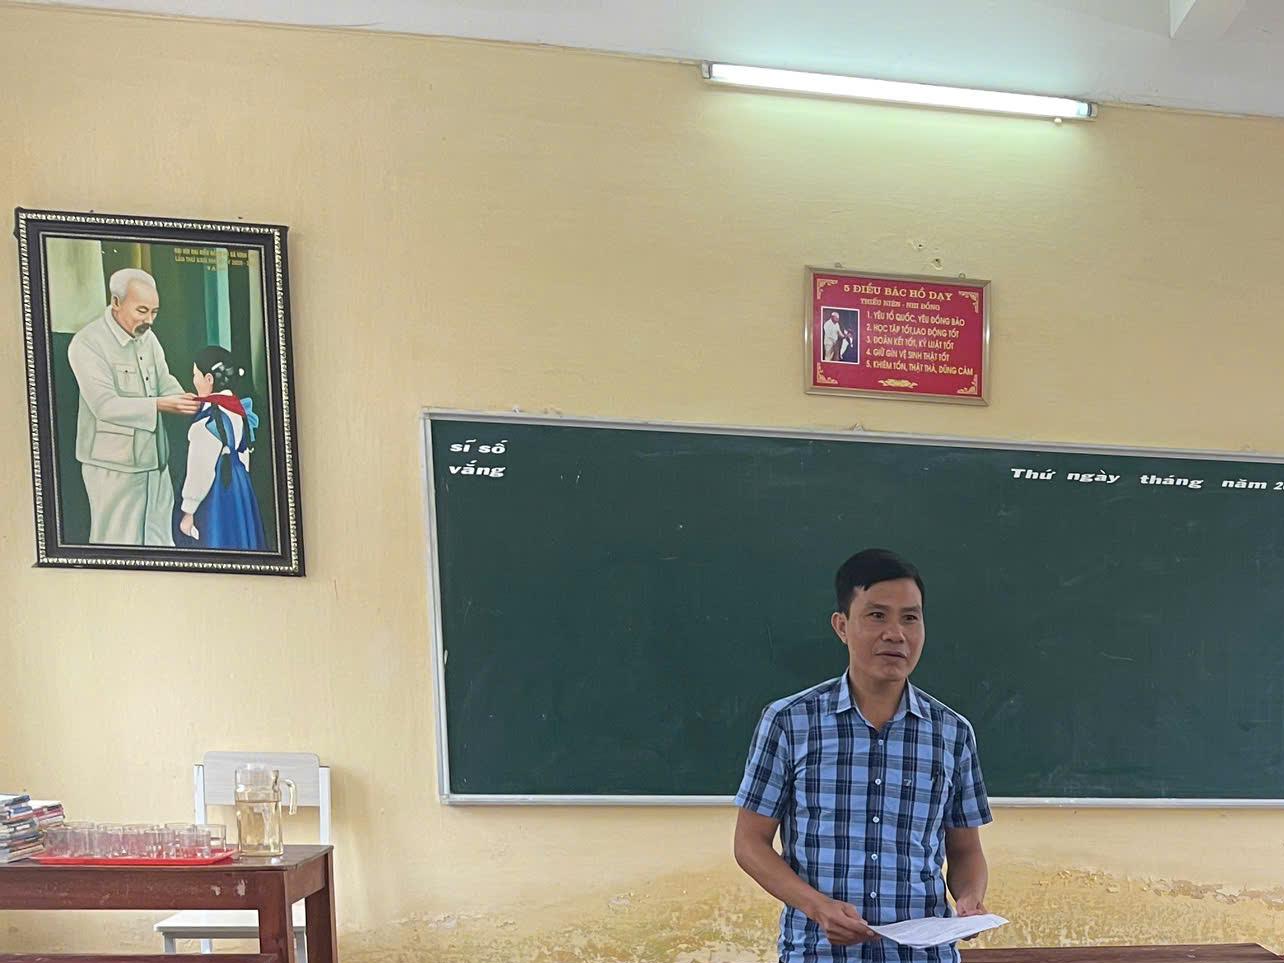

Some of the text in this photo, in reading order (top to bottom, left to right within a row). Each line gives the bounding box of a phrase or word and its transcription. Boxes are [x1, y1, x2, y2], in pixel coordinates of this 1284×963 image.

[844, 282, 953, 302] 5 ĐIỀU BÁC HỒ DẠY
[478, 440, 508, 454] số
[449, 460, 506, 478] vắng
[1011, 468, 1056, 480] Thứ
[1067, 470, 1120, 484] ngày
[1140, 475, 1204, 489] tháng
[1222, 479, 1267, 490] năm
